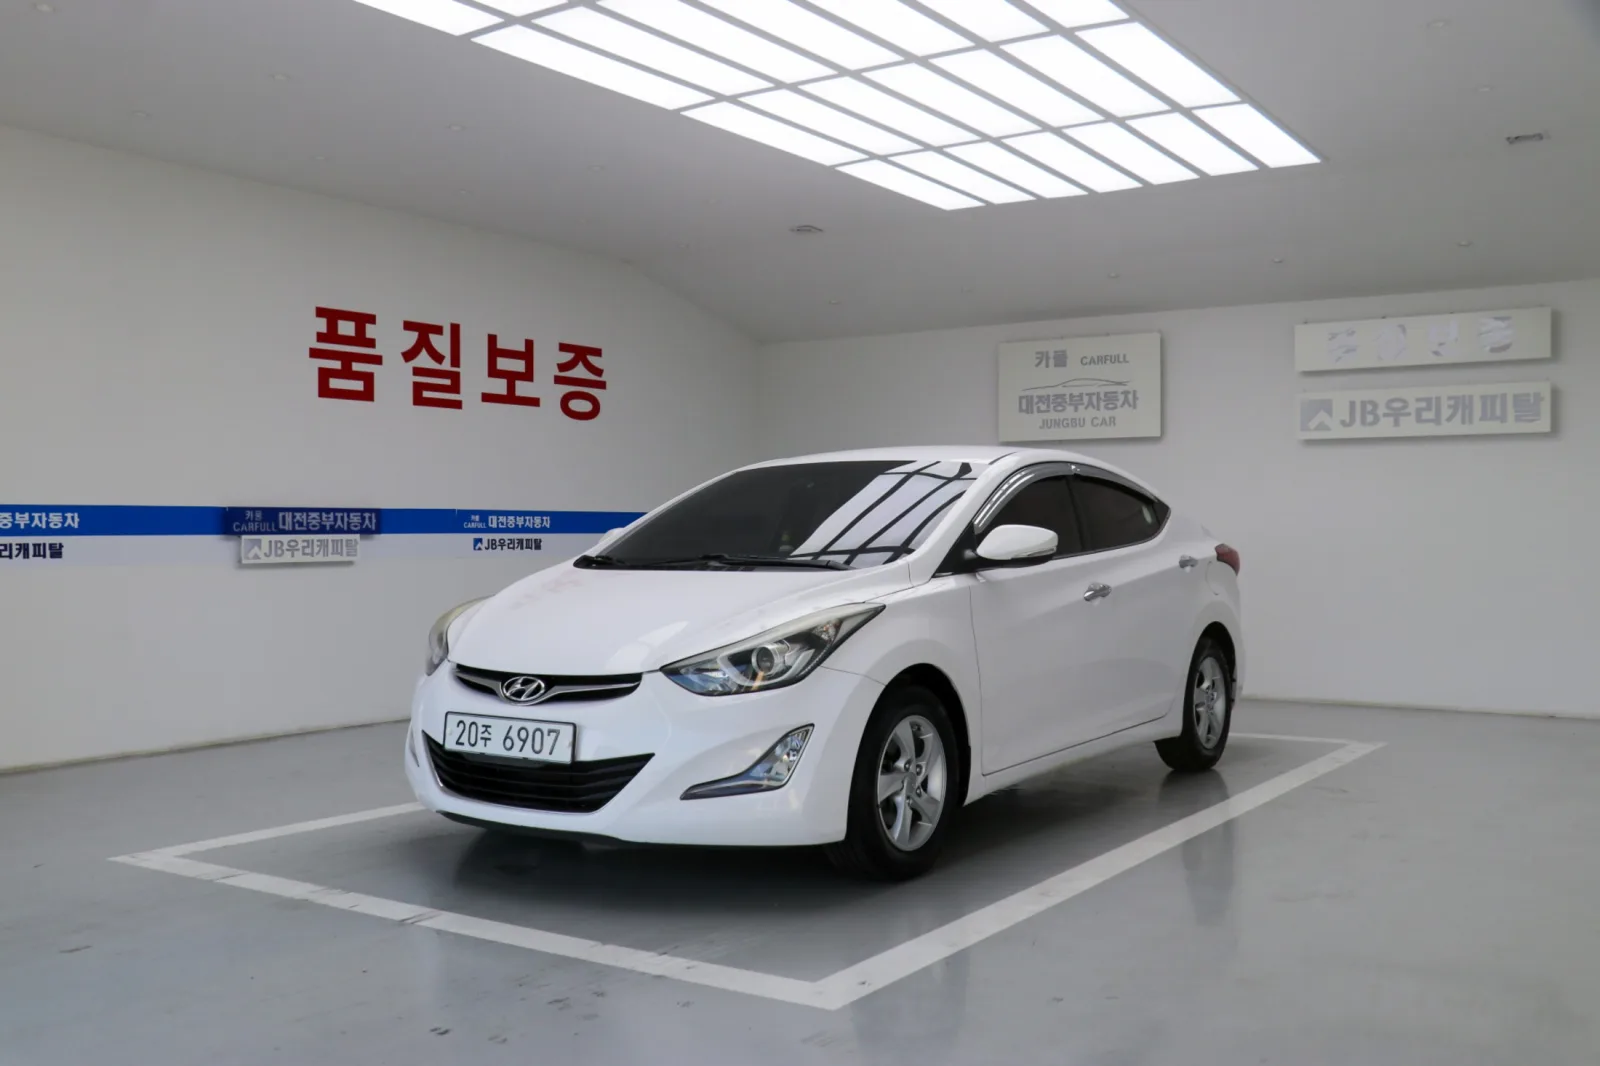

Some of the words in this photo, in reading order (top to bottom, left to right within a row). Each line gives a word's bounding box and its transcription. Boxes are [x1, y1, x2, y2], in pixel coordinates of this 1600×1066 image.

[309, 306, 606, 421] 품질보증
[1080, 353, 1130, 367] CARFULL
[1018, 389, 1139, 415] 대전중부자동차
[1339, 391, 1546, 428] JB우리캐피탈
[1039, 417, 1086, 430] JUNGBU
[1090, 416, 1116, 429] CAR
[233, 521, 277, 533] CARFULL
[278, 511, 377, 531] 대전중부자동차
[488, 515, 551, 529] 대전중부자동차
[263, 538, 360, 558] JB우리캐피탈
[484, 538, 542, 551] JB우리캐피탈
[455, 720, 492, 748] 20주
[502, 725, 561, 756] 6907
